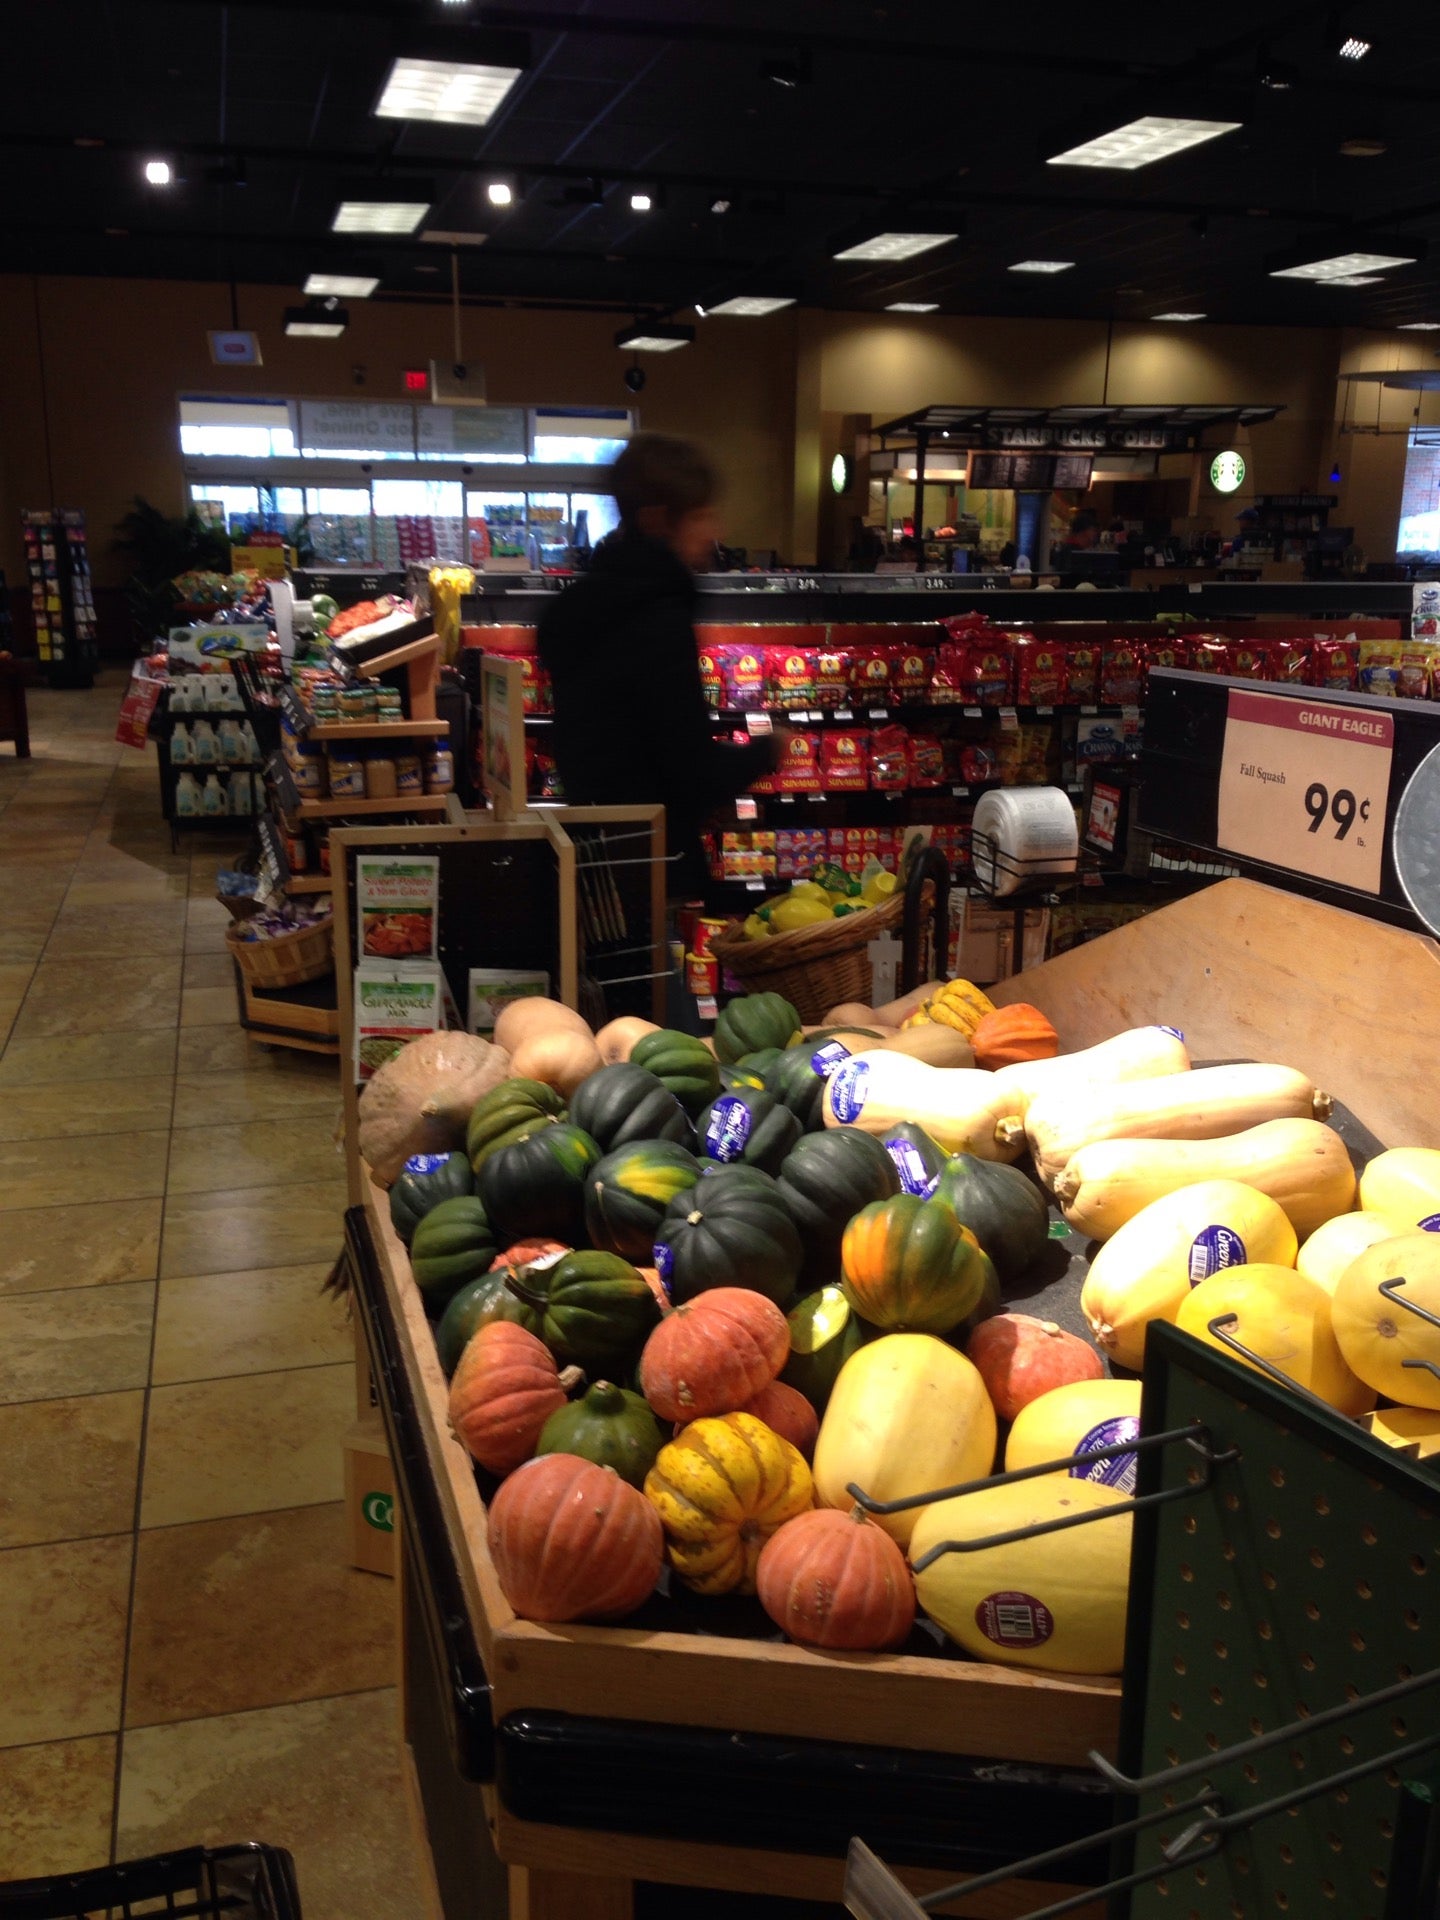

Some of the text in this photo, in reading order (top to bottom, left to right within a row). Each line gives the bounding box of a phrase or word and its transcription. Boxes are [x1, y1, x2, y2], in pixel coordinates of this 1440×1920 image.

[987, 428, 1106, 447] STARBUCKS
[1298, 711, 1384, 738] GIANT EAGLE
[1239, 763, 1286, 786] Fall Squash
[1356, 836, 1367, 848] lb.
[1216, 1229, 1233, 1269] Green
